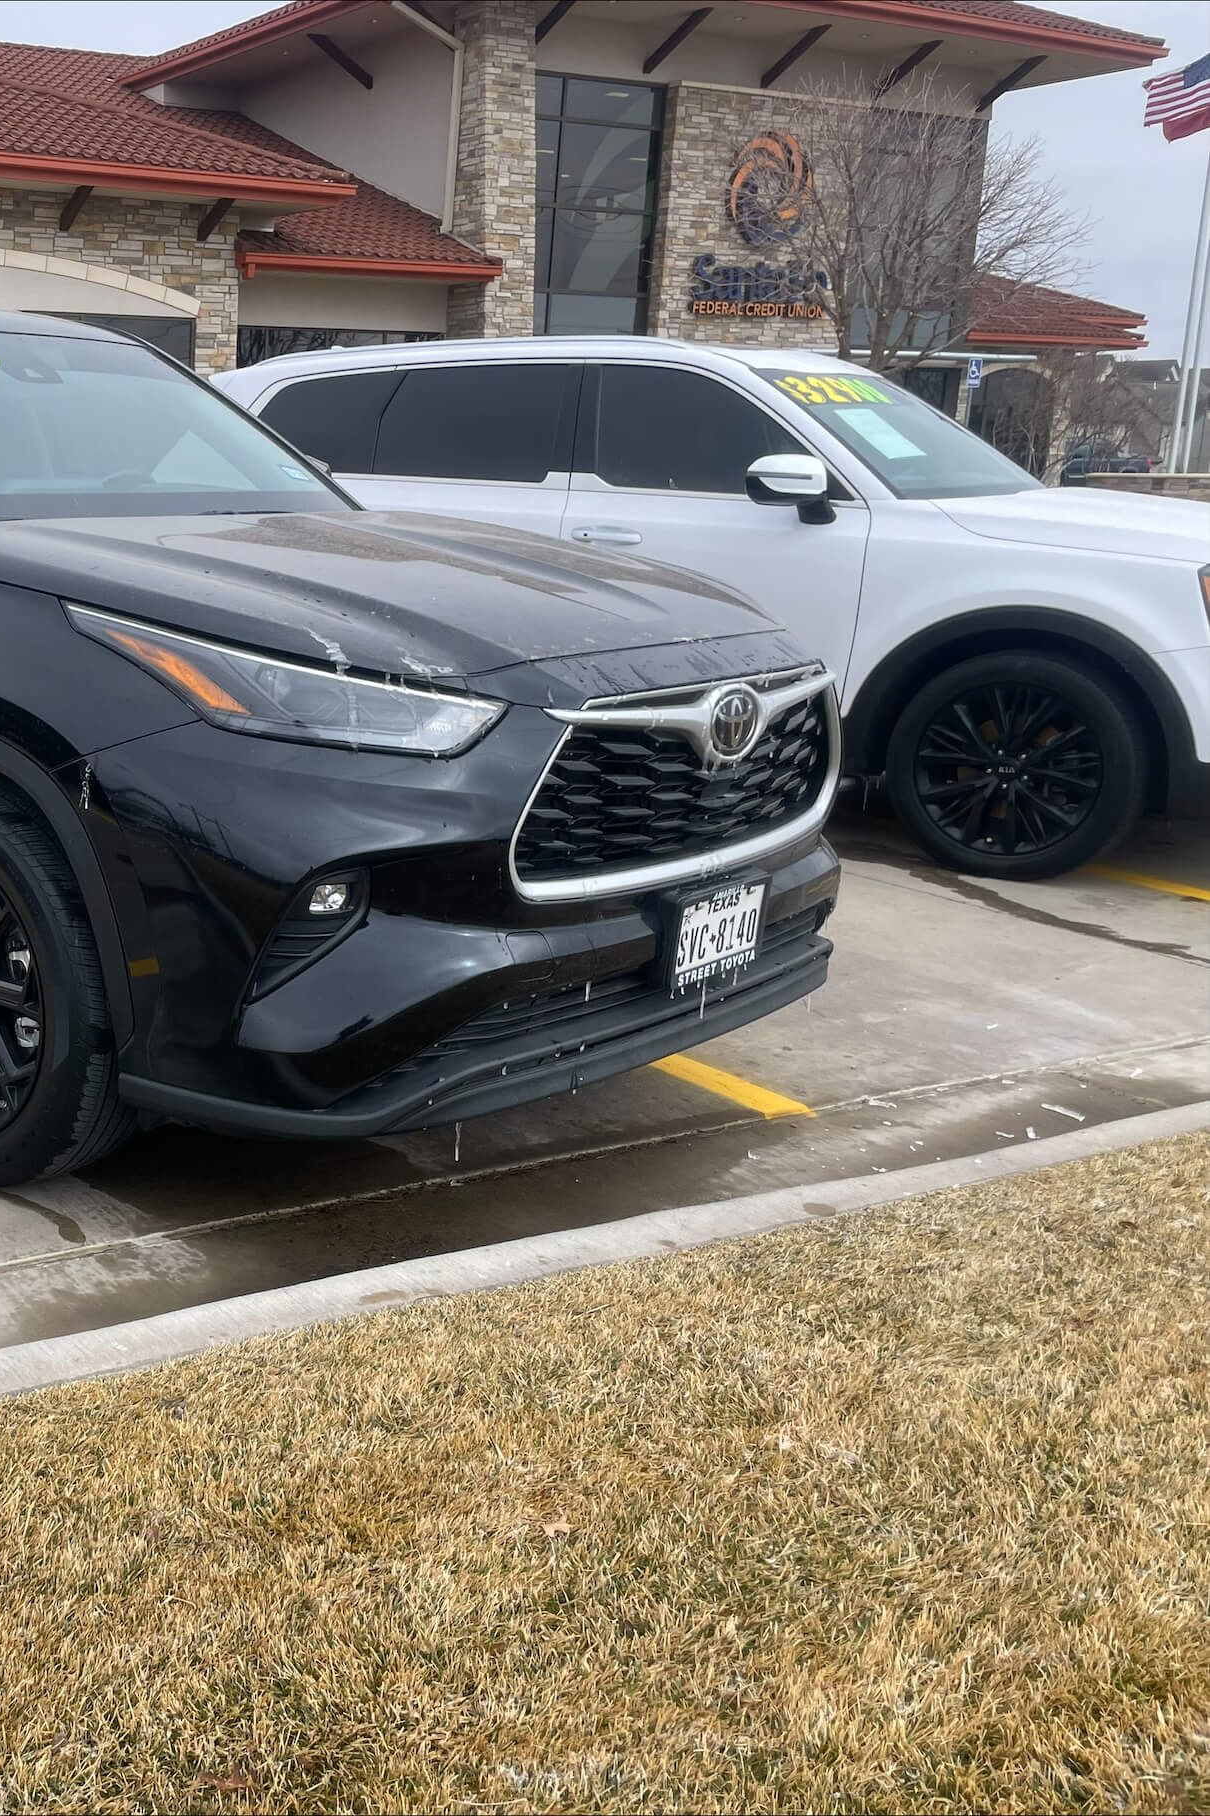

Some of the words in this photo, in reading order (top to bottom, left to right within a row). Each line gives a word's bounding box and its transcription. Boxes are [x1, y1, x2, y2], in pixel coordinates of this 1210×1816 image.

[692, 300, 743, 316] FEDERAL
[746, 302, 785, 317] CREDIT
[787, 303, 825, 319] UNION
[707, 893, 741, 915] TEXAS
[677, 962, 717, 987] STREET
[720, 949, 756, 972] TOYOTA
